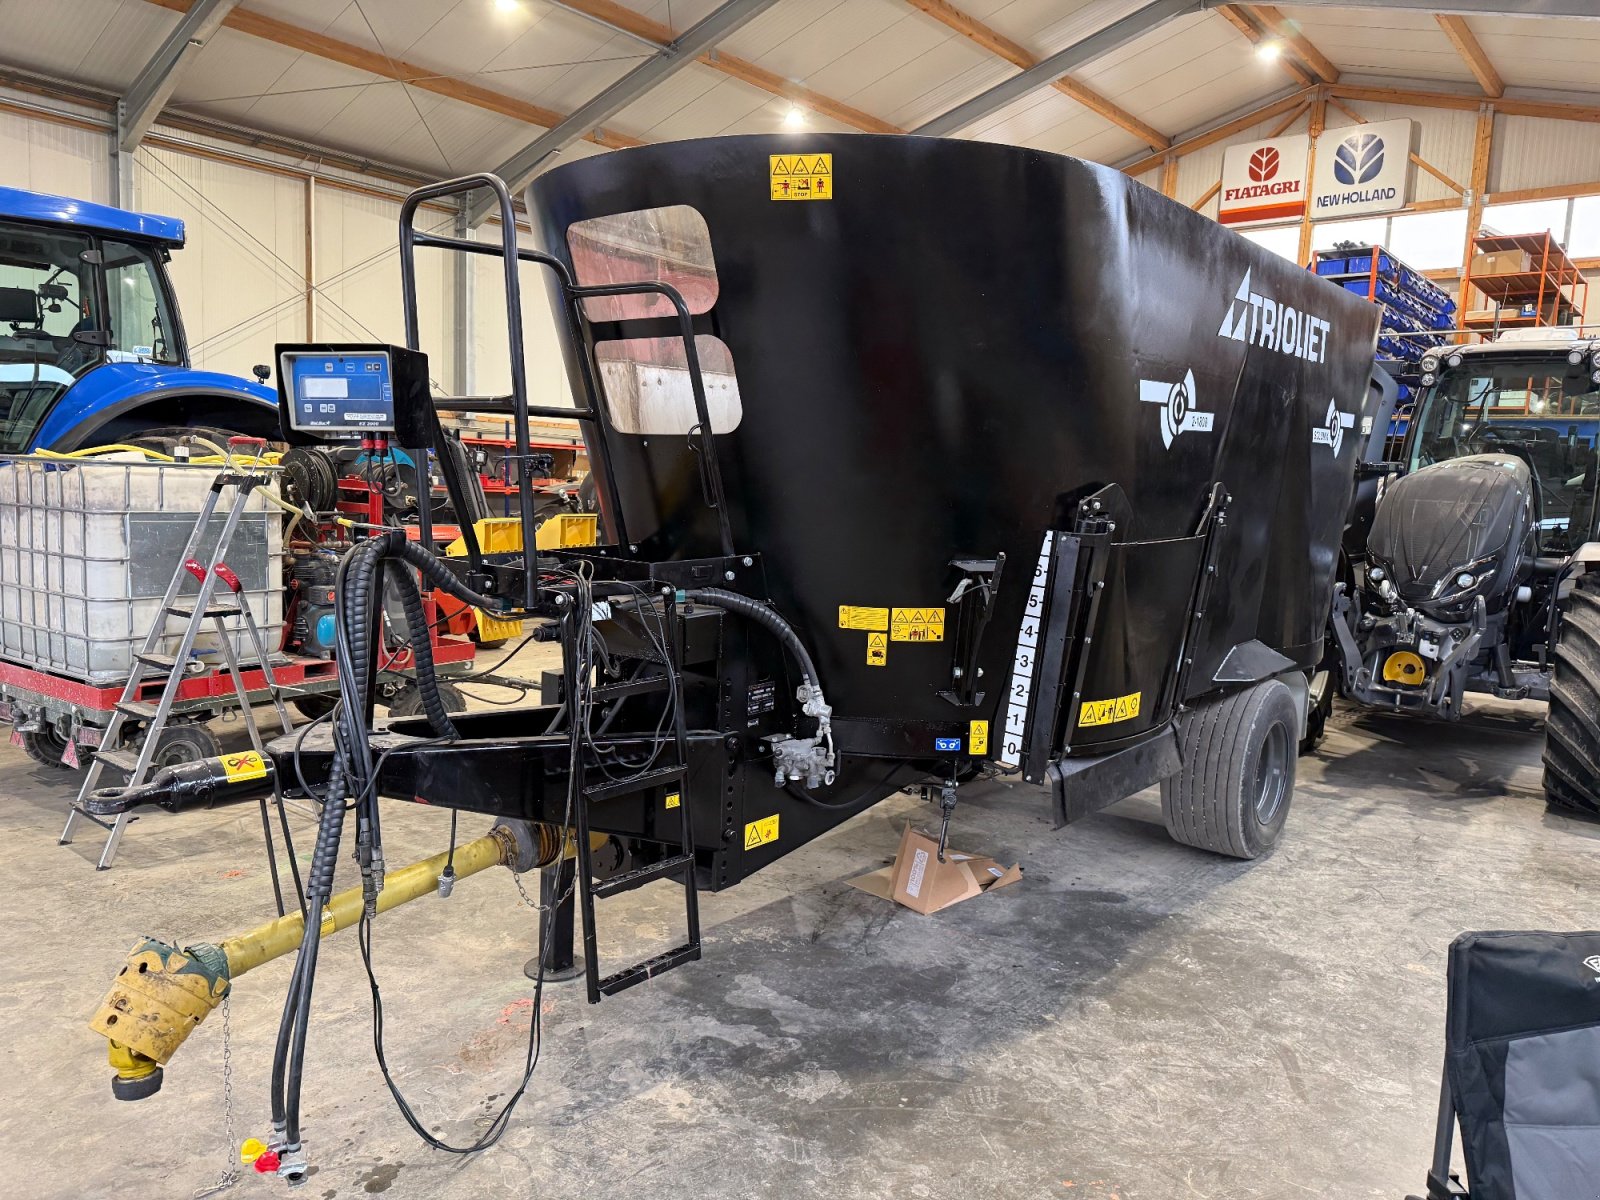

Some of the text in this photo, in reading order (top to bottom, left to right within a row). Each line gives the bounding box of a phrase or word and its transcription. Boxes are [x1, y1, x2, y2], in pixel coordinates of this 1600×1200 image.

[1225, 180, 1300, 201] FIATAGRI
[1317, 187, 1396, 208] NEW HOLLAND
[1248, 292, 1331, 364] TRIOLIET
[1034, 564, 1042, 577] 6
[1029, 594, 1038, 607] 5
[1024, 625, 1033, 638] 4
[1019, 654, 1028, 668] 3
[1015, 684, 1025, 697] 2
[1012, 713, 1019, 726] 1
[1007, 742, 1016, 755] 0
